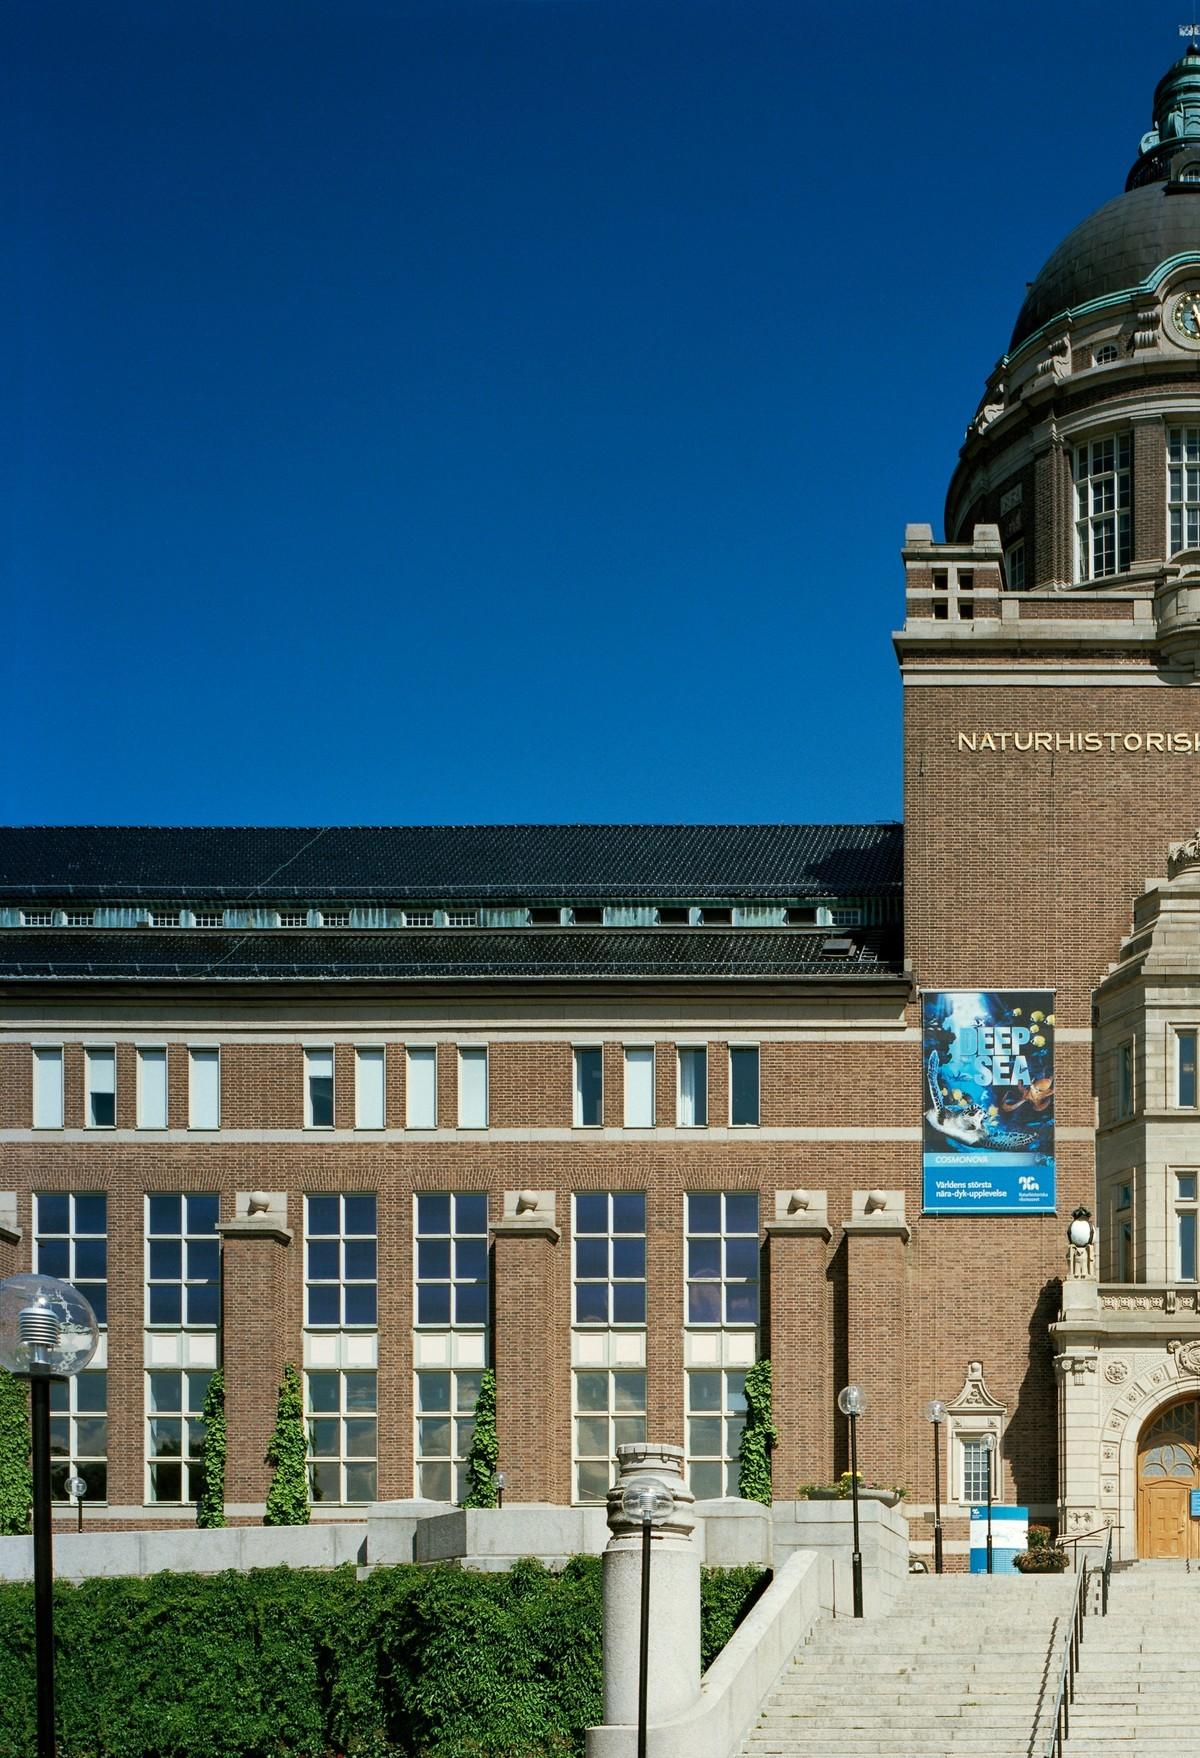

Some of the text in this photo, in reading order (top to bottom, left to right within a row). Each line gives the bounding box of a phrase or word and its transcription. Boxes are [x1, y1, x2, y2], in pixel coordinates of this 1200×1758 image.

[959, 1027, 1031, 1056] DEEP
[974, 1055, 1031, 1086] SEA
[935, 1155, 988, 1164] COSMONOVA
[935, 1180, 992, 1189] Världens största
[935, 1189, 1007, 1199] nära-dyk-upplevelse
